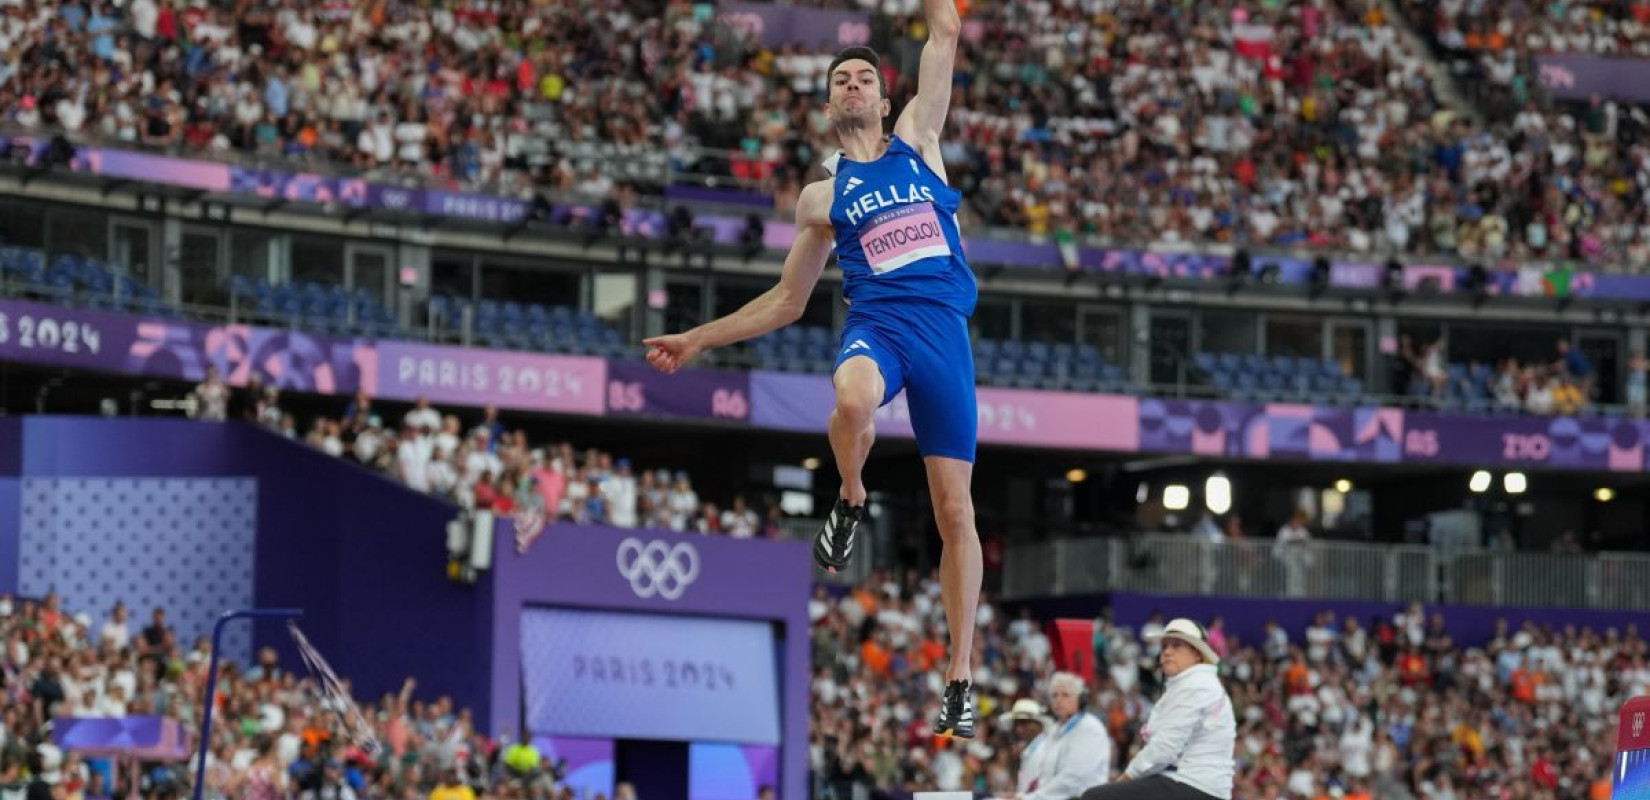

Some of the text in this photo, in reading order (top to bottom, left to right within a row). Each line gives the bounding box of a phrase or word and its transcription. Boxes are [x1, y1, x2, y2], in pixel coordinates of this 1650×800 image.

[845, 183, 935, 226] HELLAS
[864, 220, 941, 257] TENTOGLOU
[18, 315, 101, 355] 2024
[399, 355, 582, 397] PARIS 2024
[977, 402, 1036, 432] 024
[573, 654, 736, 690] PARIS 2024
